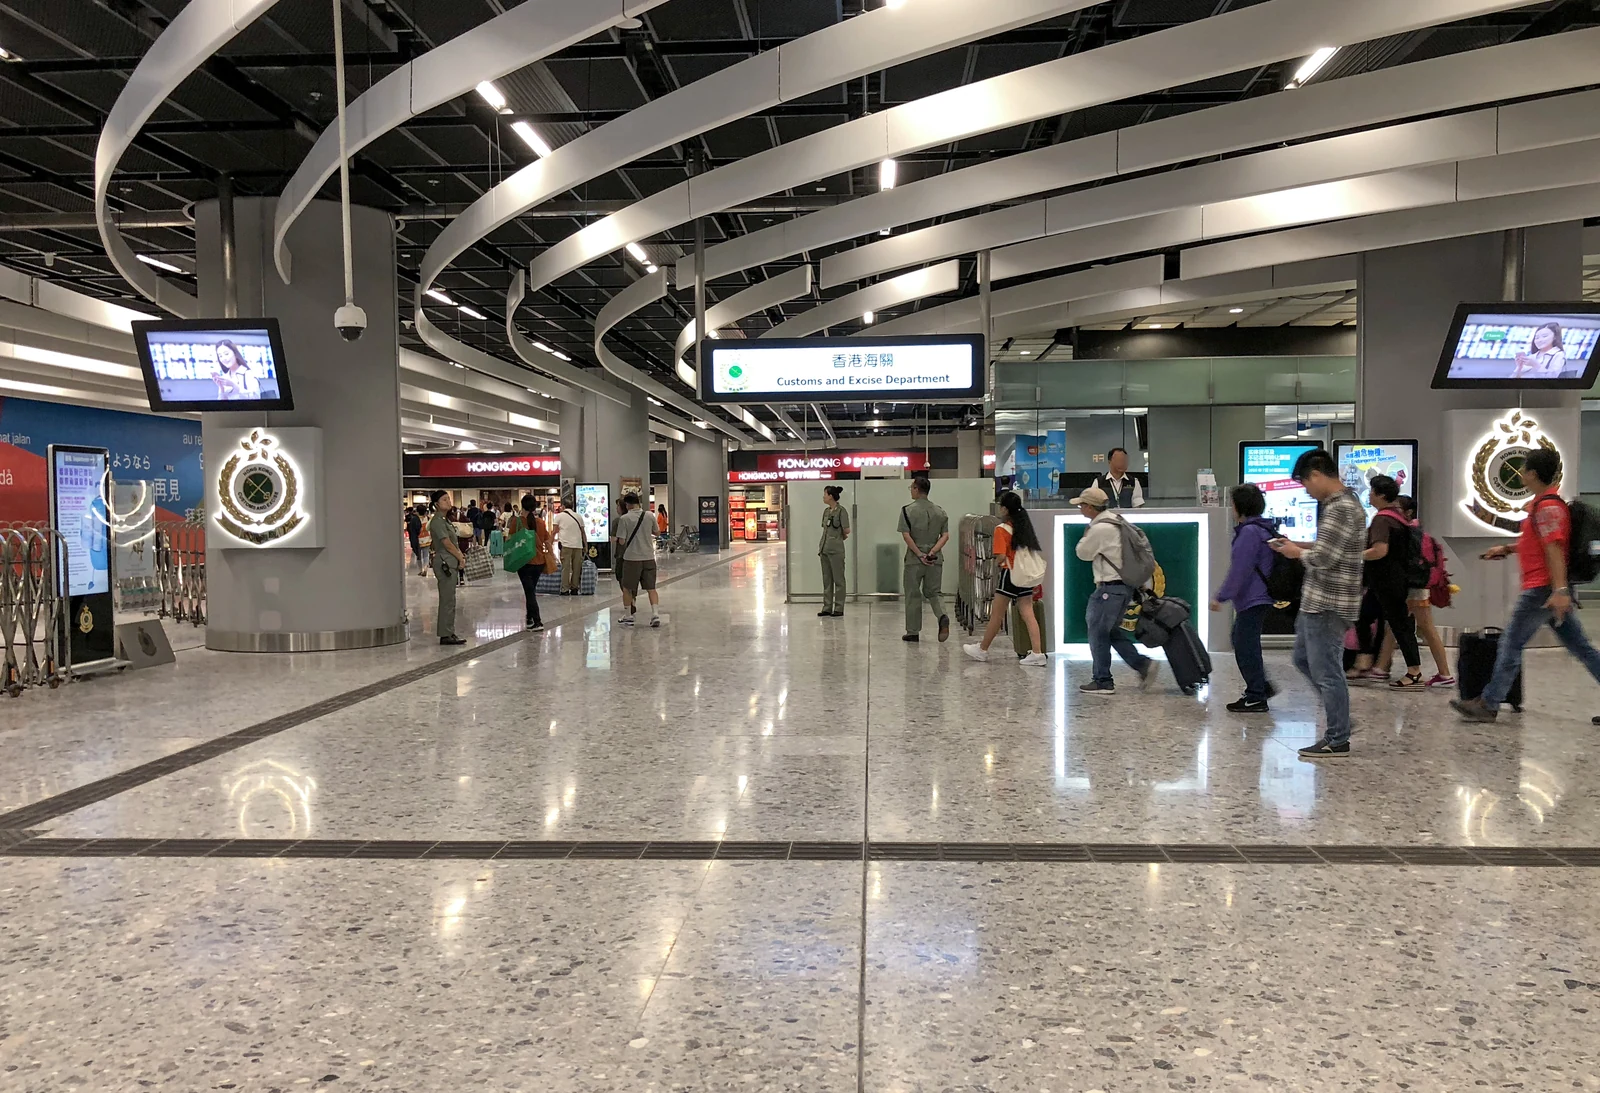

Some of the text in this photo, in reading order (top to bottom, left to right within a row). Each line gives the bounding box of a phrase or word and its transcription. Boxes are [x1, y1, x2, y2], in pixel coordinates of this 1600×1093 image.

[832, 353, 893, 368] 香港海關
[777, 374, 950, 386] Customs and Excise Department
[1500, 450, 1517, 460] HONG
[243, 467, 258, 476] HONG
[1493, 477, 1513, 496] CUSTOMS
[238, 492, 256, 509] CUSTOMS
